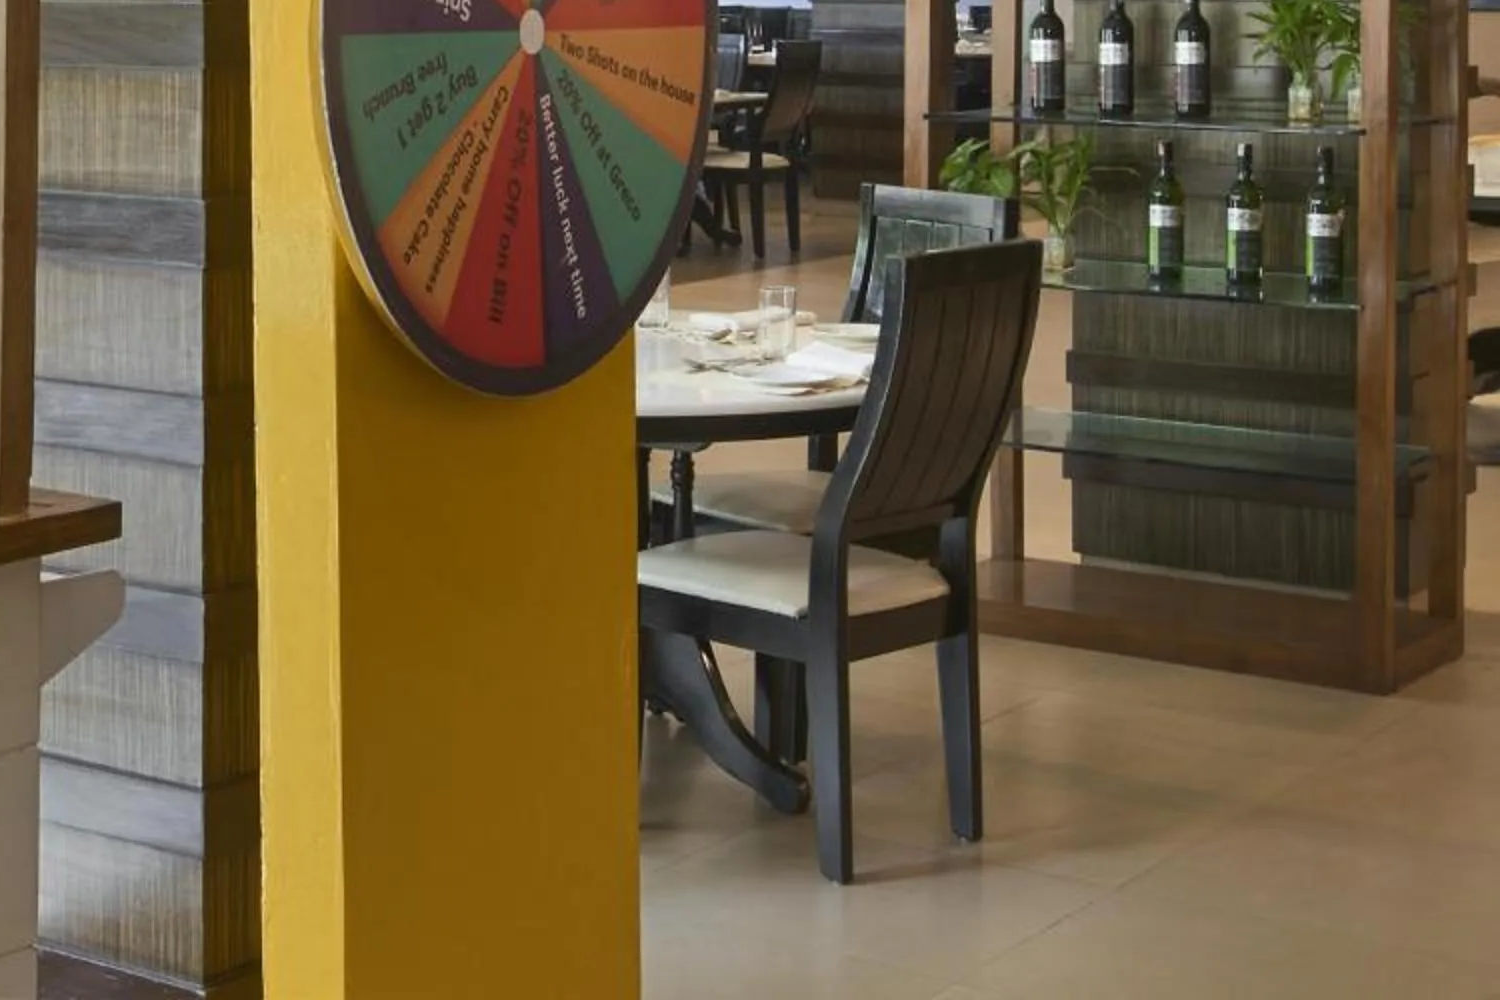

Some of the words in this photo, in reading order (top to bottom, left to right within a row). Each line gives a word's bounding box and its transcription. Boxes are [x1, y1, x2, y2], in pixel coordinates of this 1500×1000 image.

[417, 51, 448, 82] free
[448, 64, 479, 101] Buy
[560, 33, 585, 61] Two
[586, 45, 621, 76] Shots
[621, 64, 638, 82] on
[638, 67, 659, 91] the
[660, 73, 696, 105] house
[362, 72, 417, 122] Brunch
[406, 95, 434, 137] get
[435, 90, 448, 115] 2
[481, 86, 510, 140] Carry
[397, 126, 409, 151] 1
[540, 93, 559, 161] Better
[557, 68, 583, 116] 20%
[580, 111, 603, 148] Off
[596, 145, 613, 171] at
[608, 163, 642, 223] Greco
[425, 130, 475, 219] Chocolate
[461, 140, 490, 197] home
[552, 165, 571, 214] luck
[403, 218, 430, 266] Cake
[425, 197, 467, 294] happiness
[497, 233, 512, 274] on
[560, 217, 579, 267] next
[570, 267, 588, 319] time
